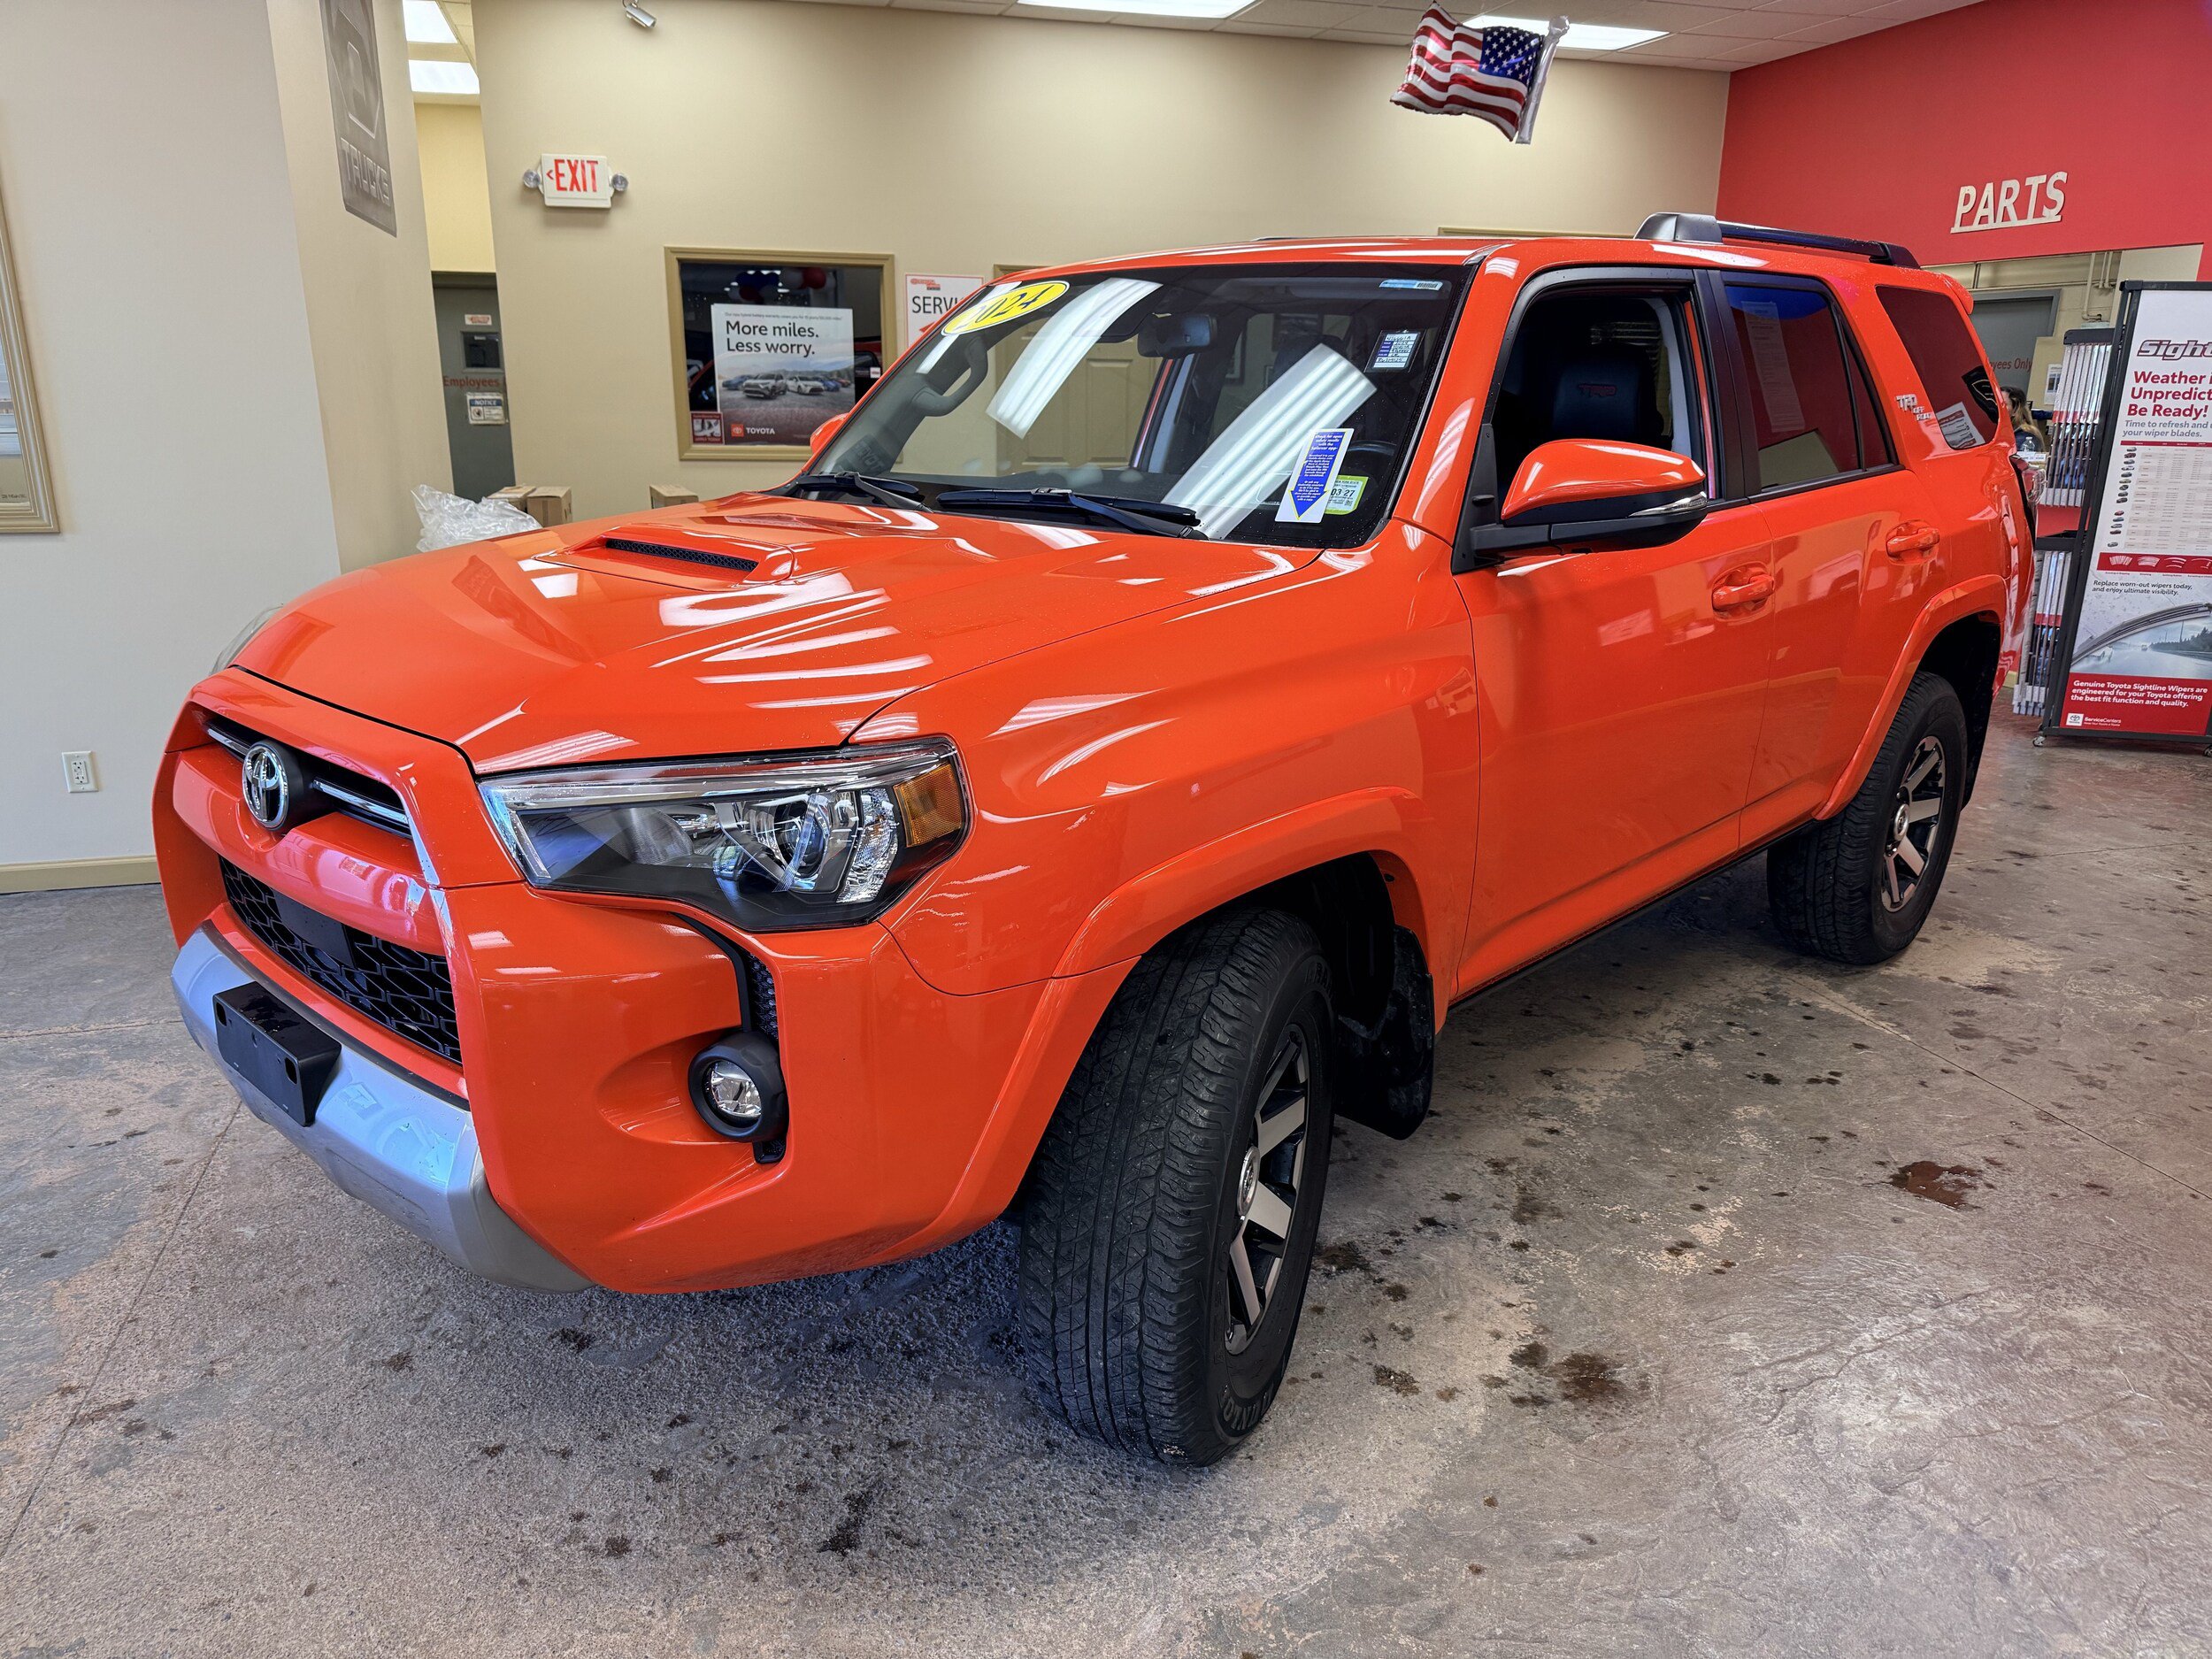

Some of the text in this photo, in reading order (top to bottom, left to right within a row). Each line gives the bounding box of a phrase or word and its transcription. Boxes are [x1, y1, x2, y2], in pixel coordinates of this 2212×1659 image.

[341, 137, 391, 207] TRUCKS
[554, 158, 599, 193] EXIT
[1950, 171, 2068, 232] PARTS
[911, 295, 964, 315] SERV
[726, 319, 819, 338] More miles.
[726, 337, 816, 358] Less worry.
[443, 376, 501, 389] Employees
[2133, 371, 2207, 385] Weather
[1896, 394, 1918, 412] TRD
[2127, 403, 2209, 421] Be Ready!
[746, 426, 776, 435] TOYOTA
[2124, 419, 2147, 428] Time
[2158, 420, 2190, 429] refresh
[2144, 429, 2170, 438] wiper
[2170, 429, 2203, 438] blades.
[1331, 488, 1342, 496] 03
[2071, 687, 2115, 697] engineered
[2073, 680, 2106, 688] Genuine
[2106, 681, 2131, 690] Toyota
[2132, 683, 2167, 692] Sightline
[2168, 685, 2194, 694] Wipers
[2112, 696, 2144, 705] function
[2161, 699, 2189, 708] quality.
